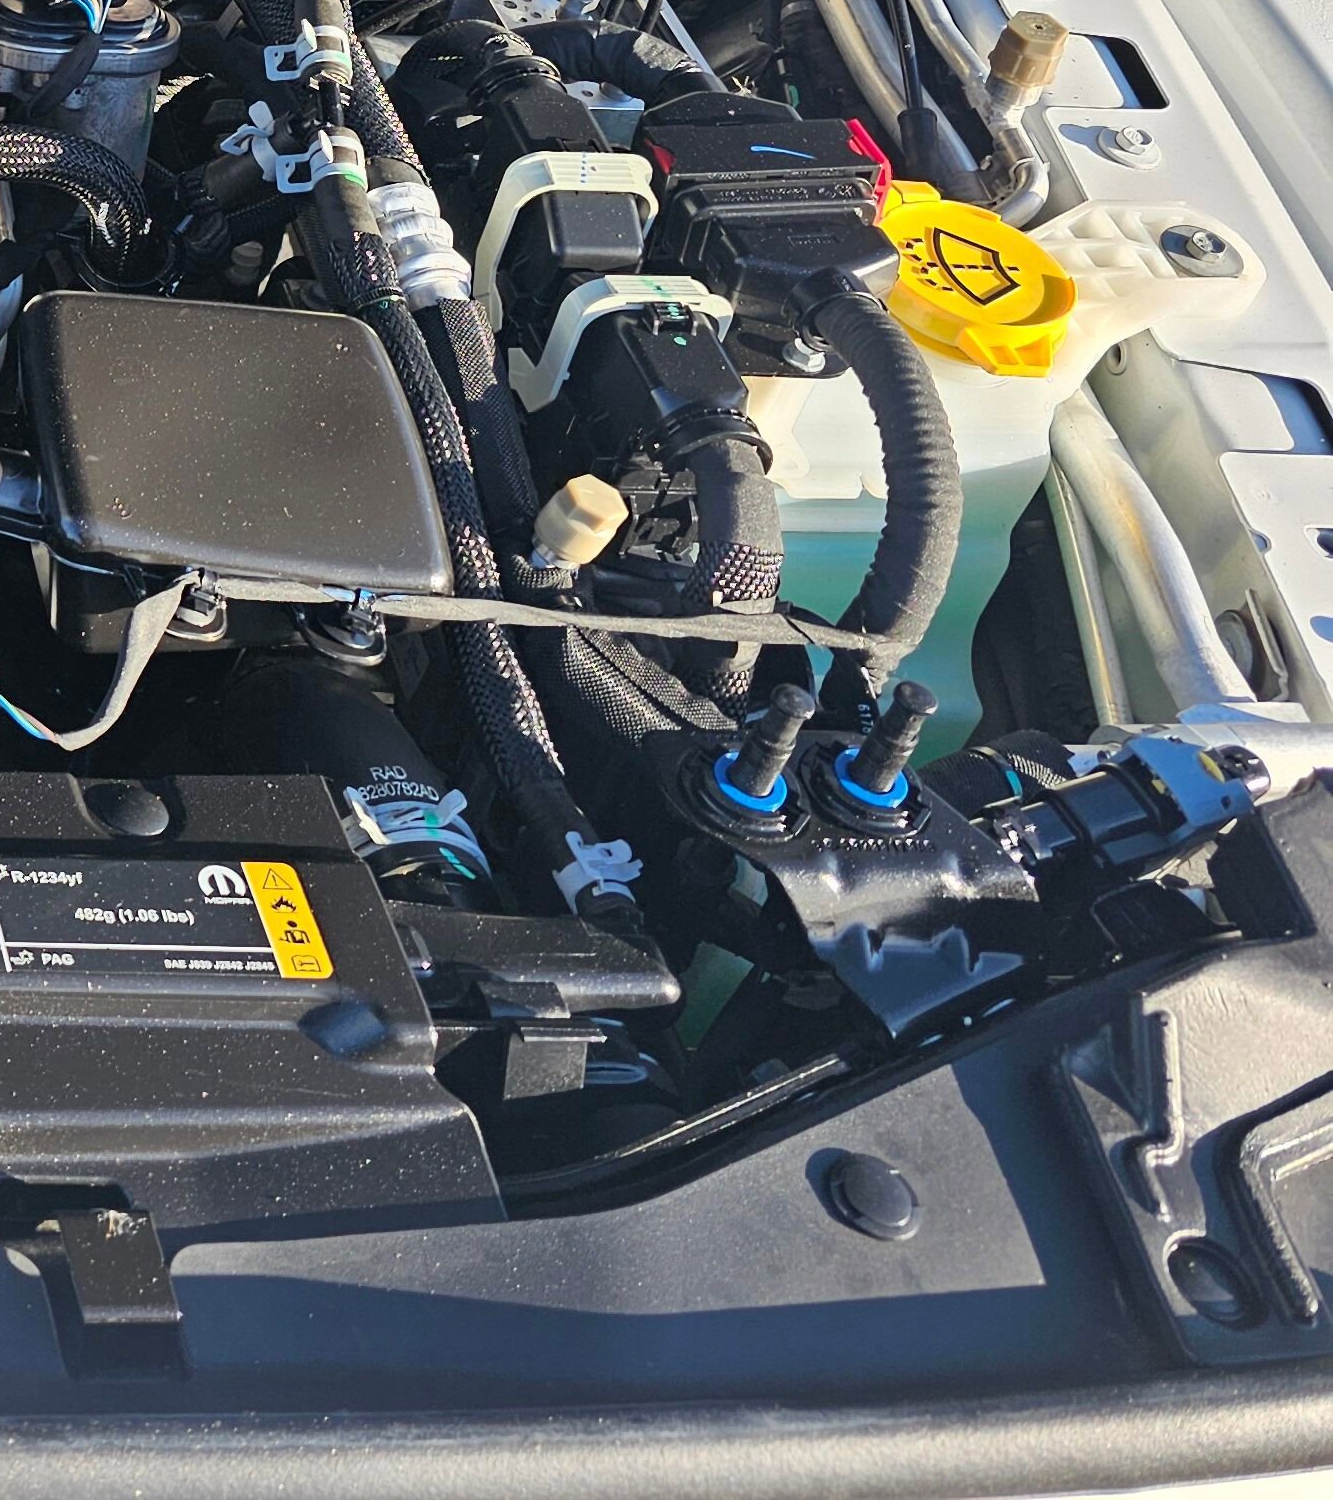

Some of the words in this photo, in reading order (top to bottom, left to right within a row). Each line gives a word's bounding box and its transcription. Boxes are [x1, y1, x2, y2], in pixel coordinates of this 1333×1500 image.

[369, 765, 408, 781] RAD
[10, 870, 83, 888] R-1234yf
[41, 952, 75, 966] PAG
